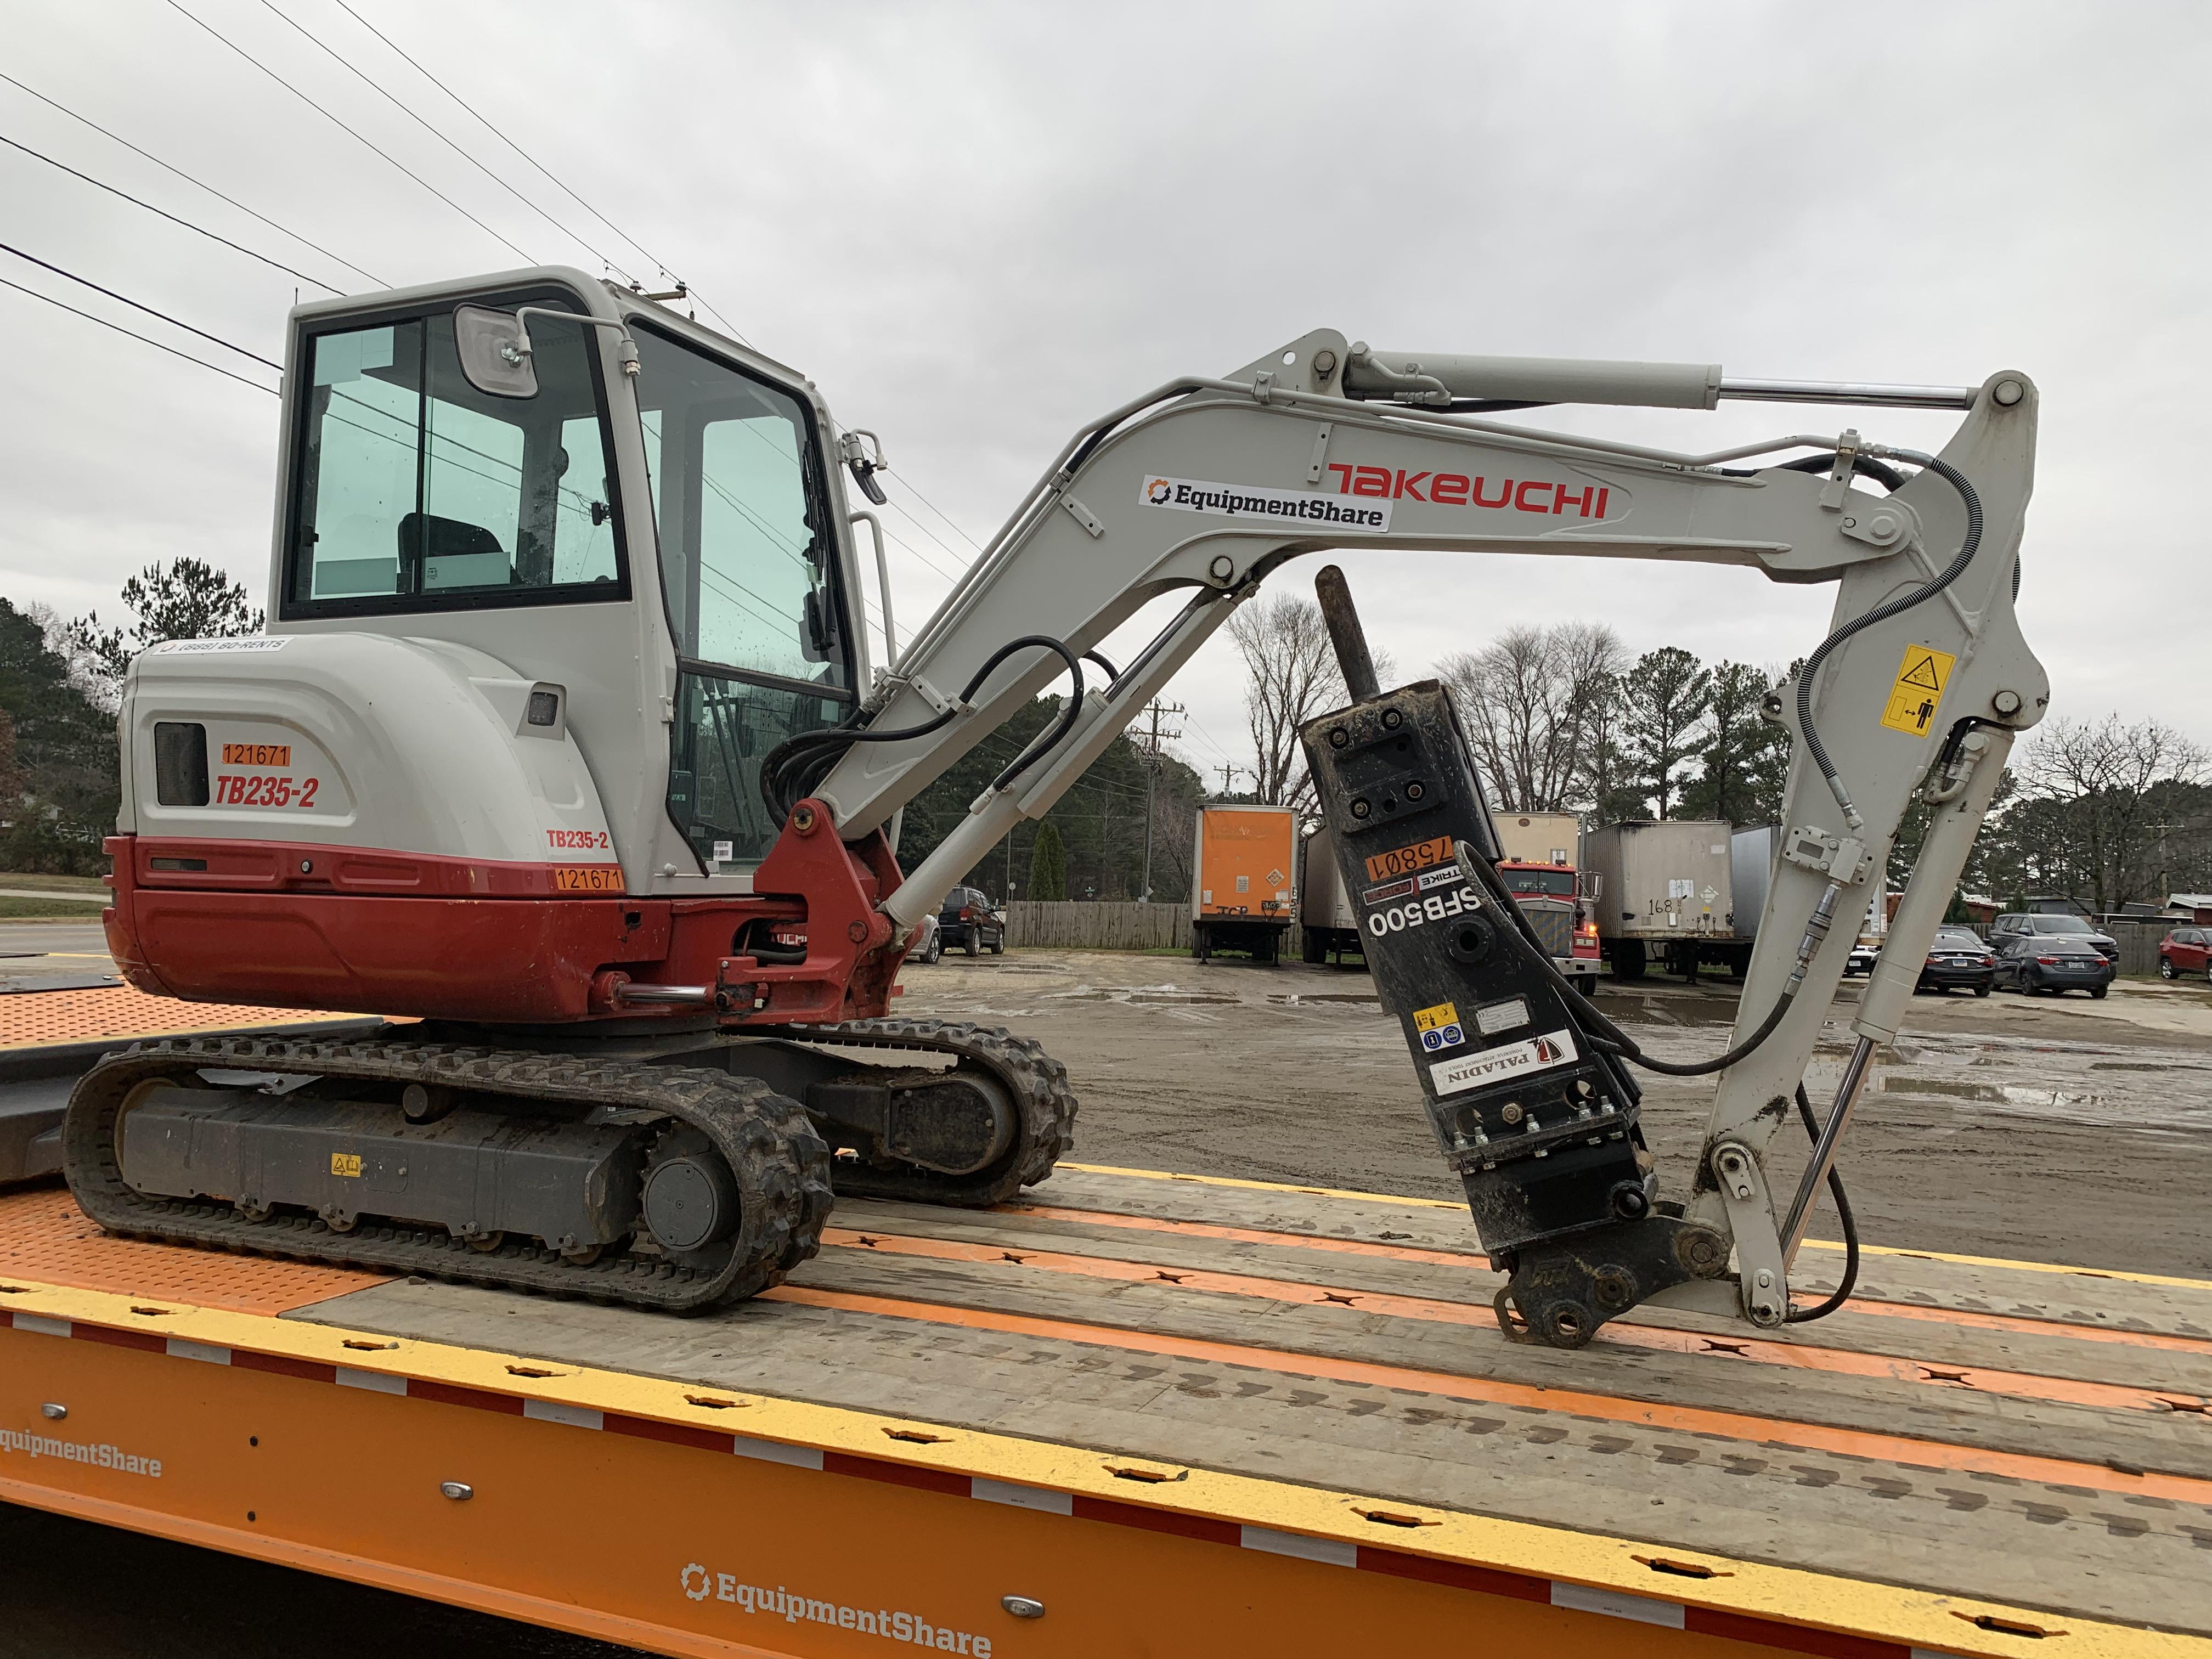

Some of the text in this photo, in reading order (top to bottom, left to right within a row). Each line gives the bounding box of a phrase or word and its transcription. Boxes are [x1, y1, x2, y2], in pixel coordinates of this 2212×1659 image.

[1174, 484, 1384, 528] EquipmentShare
[224, 744, 287, 765] 121671
[216, 776, 319, 808] TB235-2
[546, 829, 609, 849] TB235-2
[1372, 839, 1453, 879] 75801
[557, 869, 621, 889] 121671
[1421, 869, 1462, 885] TRIKE
[1369, 886, 1481, 936] SFB500
[1649, 899, 1672, 915] 168
[776, 933, 807, 945] UCHI
[1447, 1053, 1530, 1084] PALADIN
[1448, 1048, 1522, 1071] POWERFUL ATTACHMENT TOOLS
[0, 1429, 162, 1478] quipmentShare
[716, 1572, 992, 1659] EquipmentShare
